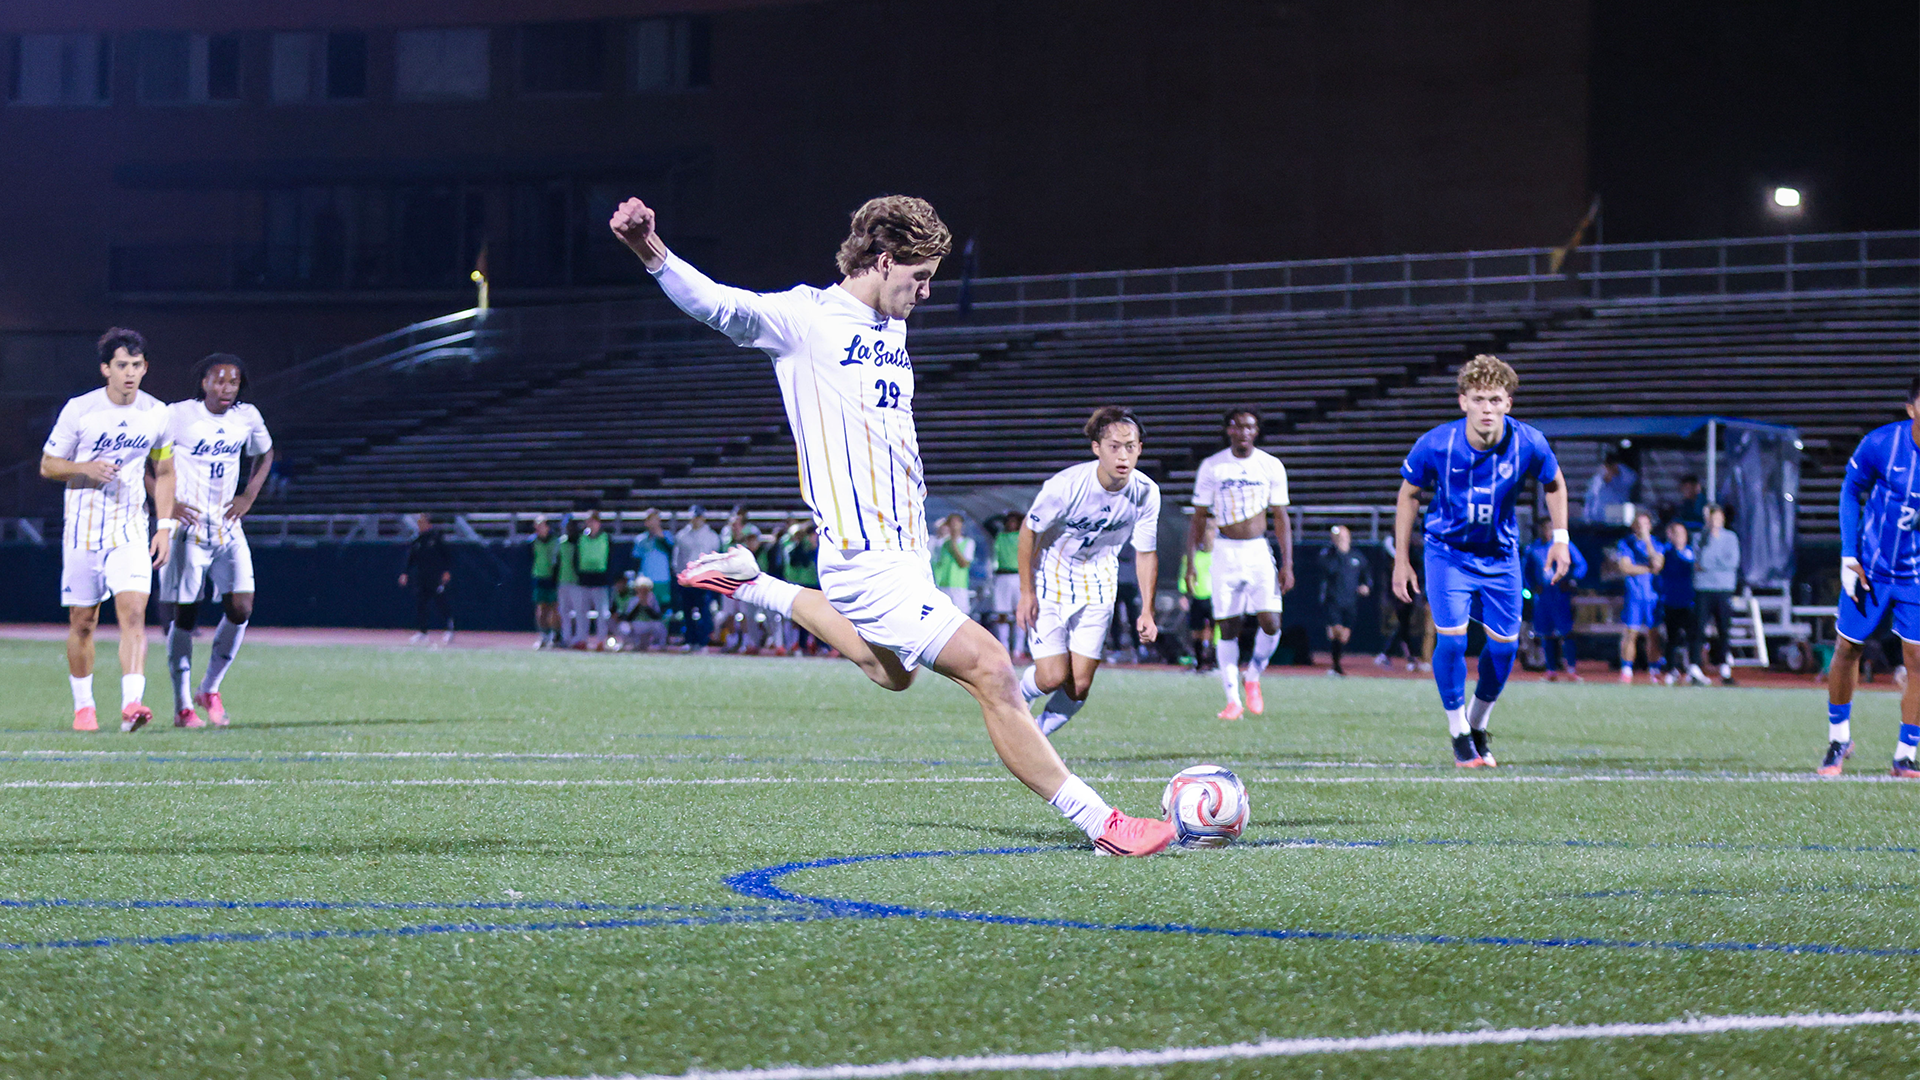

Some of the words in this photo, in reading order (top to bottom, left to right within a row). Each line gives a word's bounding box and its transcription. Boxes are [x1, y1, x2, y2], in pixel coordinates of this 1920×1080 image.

[839, 334, 872, 366] La
[875, 379, 901, 408] 29
[92, 432, 114, 452] La
[112, 432, 150, 451] Salle
[190, 438, 211, 456] La
[211, 439, 243, 456] Sall
[210, 462, 224, 479] 10
[1467, 502, 1494, 524] 18
